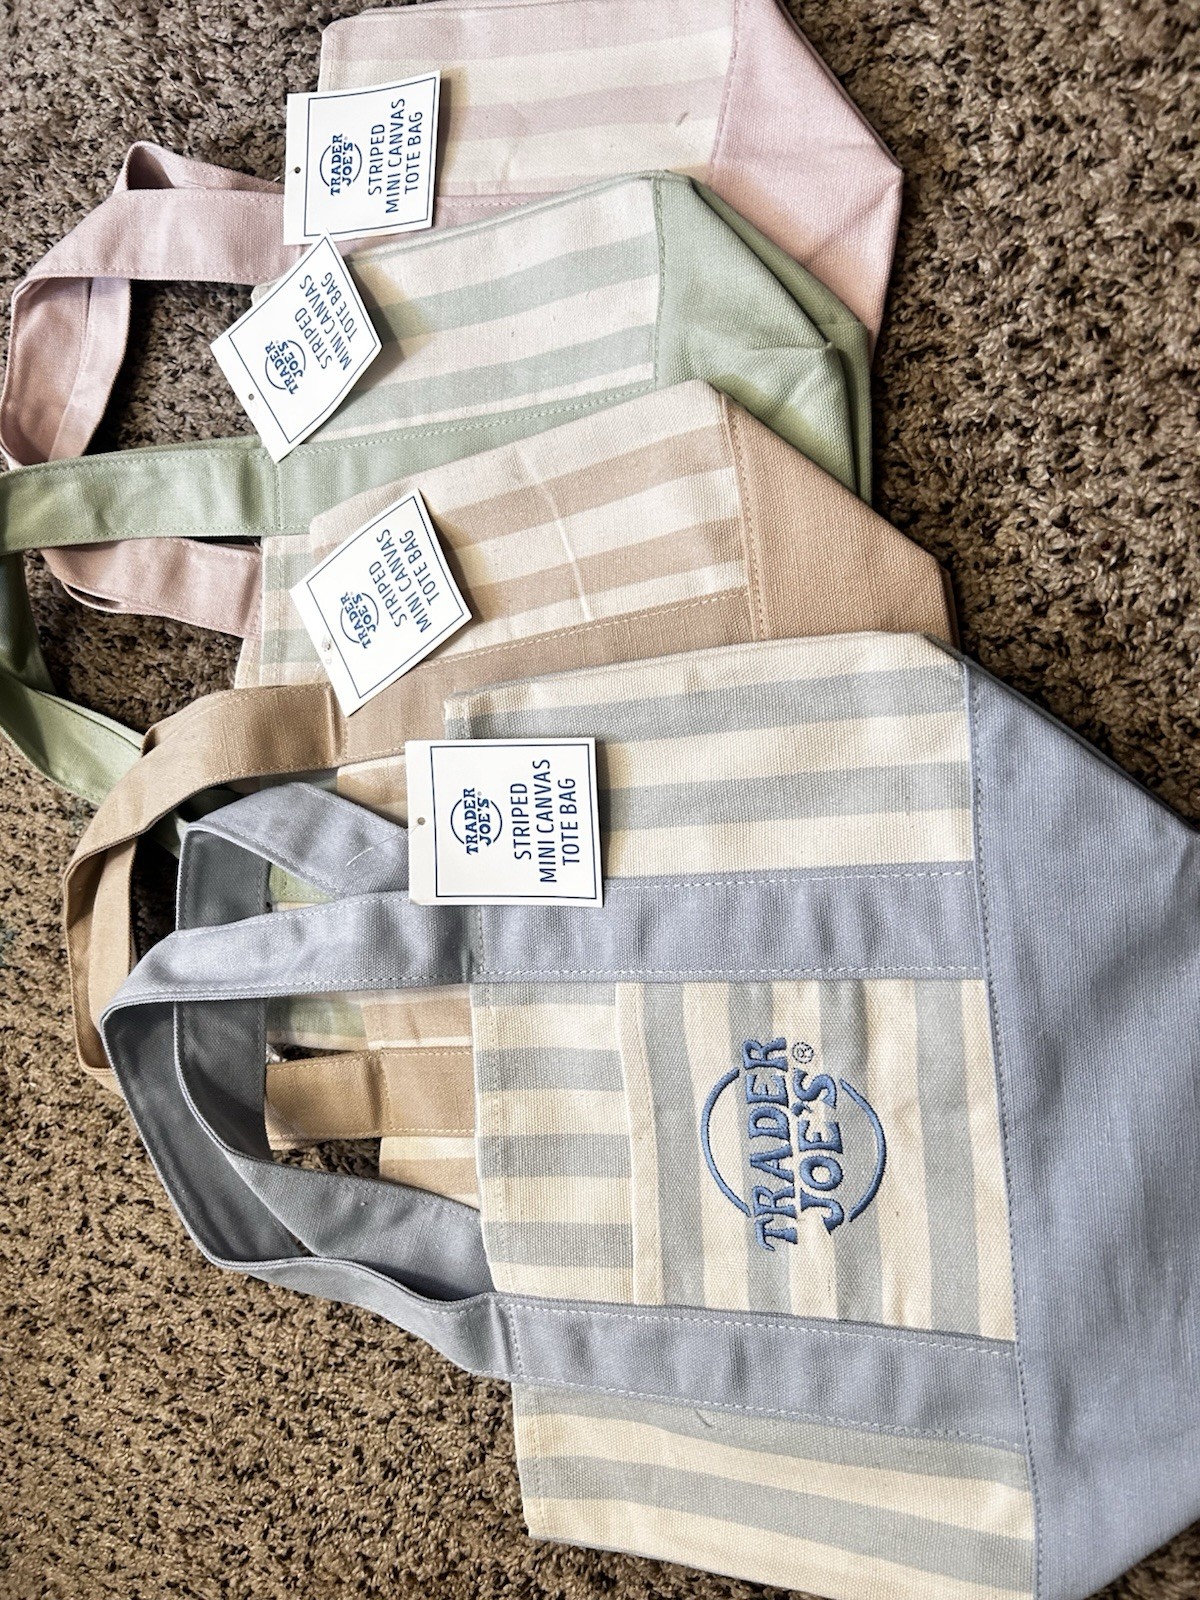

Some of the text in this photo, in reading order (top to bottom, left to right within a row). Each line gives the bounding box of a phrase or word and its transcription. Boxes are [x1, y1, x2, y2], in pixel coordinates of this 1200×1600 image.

[331, 134, 343, 196] TRADER
[342, 142, 353, 186] JOE'S
[368, 124, 385, 195] STRIPED
[386, 98, 405, 213] MINI CANVAS
[405, 111, 423, 194] TOTE BAG
[294, 307, 332, 369] STRIPED
[300, 275, 352, 371] MINI CANVAS
[321, 272, 357, 339] TOTE BAG
[265, 341, 298, 394] TRADER
[277, 341, 303, 377] JOE'S
[368, 561, 407, 627] STRIPED
[376, 529, 432, 632] MINI CANVAS
[400, 530, 440, 605] TOTE BAG
[340, 592, 372, 649] TRADER
[352, 593, 376, 632] JOE'S
[463, 788, 478, 855] TRADER
[477, 798, 491, 846] JOE'S
[510, 783, 531, 859] STRIPED
[532, 759, 557, 882] MINI CANVAS
[558, 778, 580, 865] TOTE BAG
[742, 1037, 798, 1251] TRADER
[792, 1068, 844, 1235] JOE'S
